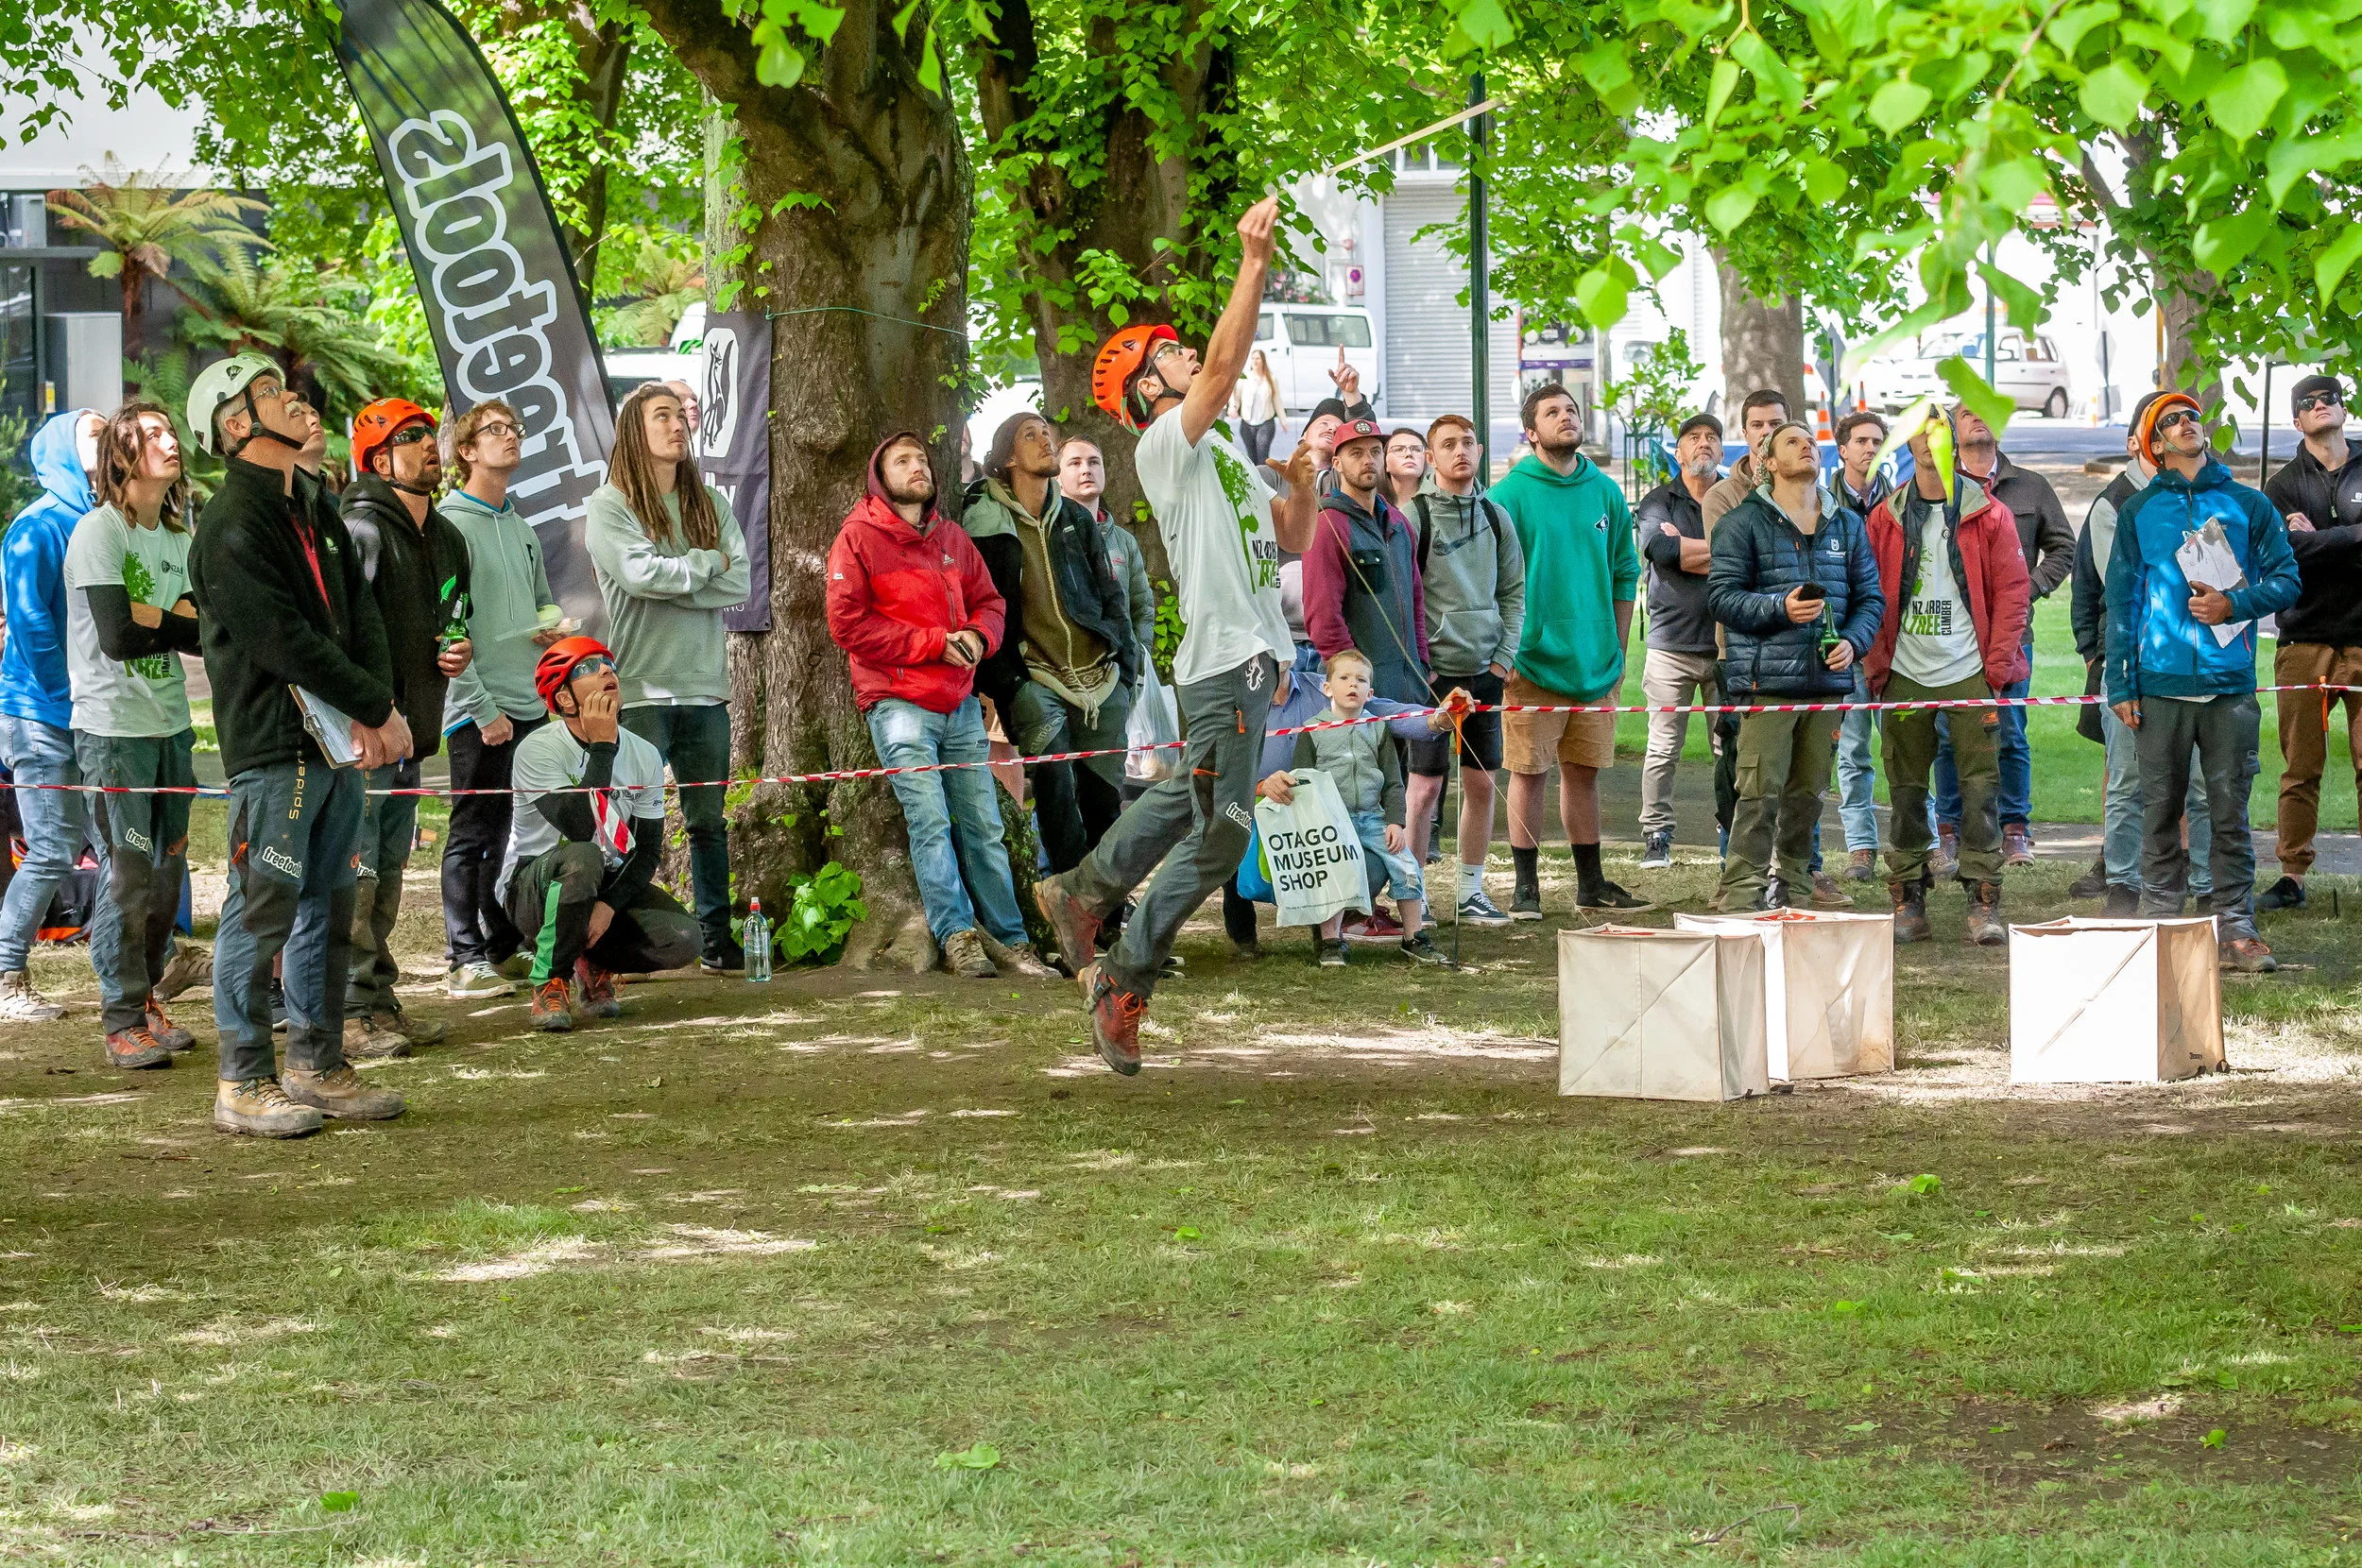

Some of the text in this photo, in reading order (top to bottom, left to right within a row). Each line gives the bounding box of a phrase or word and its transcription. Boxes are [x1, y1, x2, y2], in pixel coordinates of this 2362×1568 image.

[1912, 600, 1923, 615] NZ
[1941, 600, 1952, 636] CLIMBER
[1908, 614, 1941, 636] TREE
[288, 758, 306, 820] Spider
[1268, 825, 1338, 852] OTAGO
[1273, 844, 1359, 872] MUSEUM
[1279, 870, 1328, 892] SHOP
